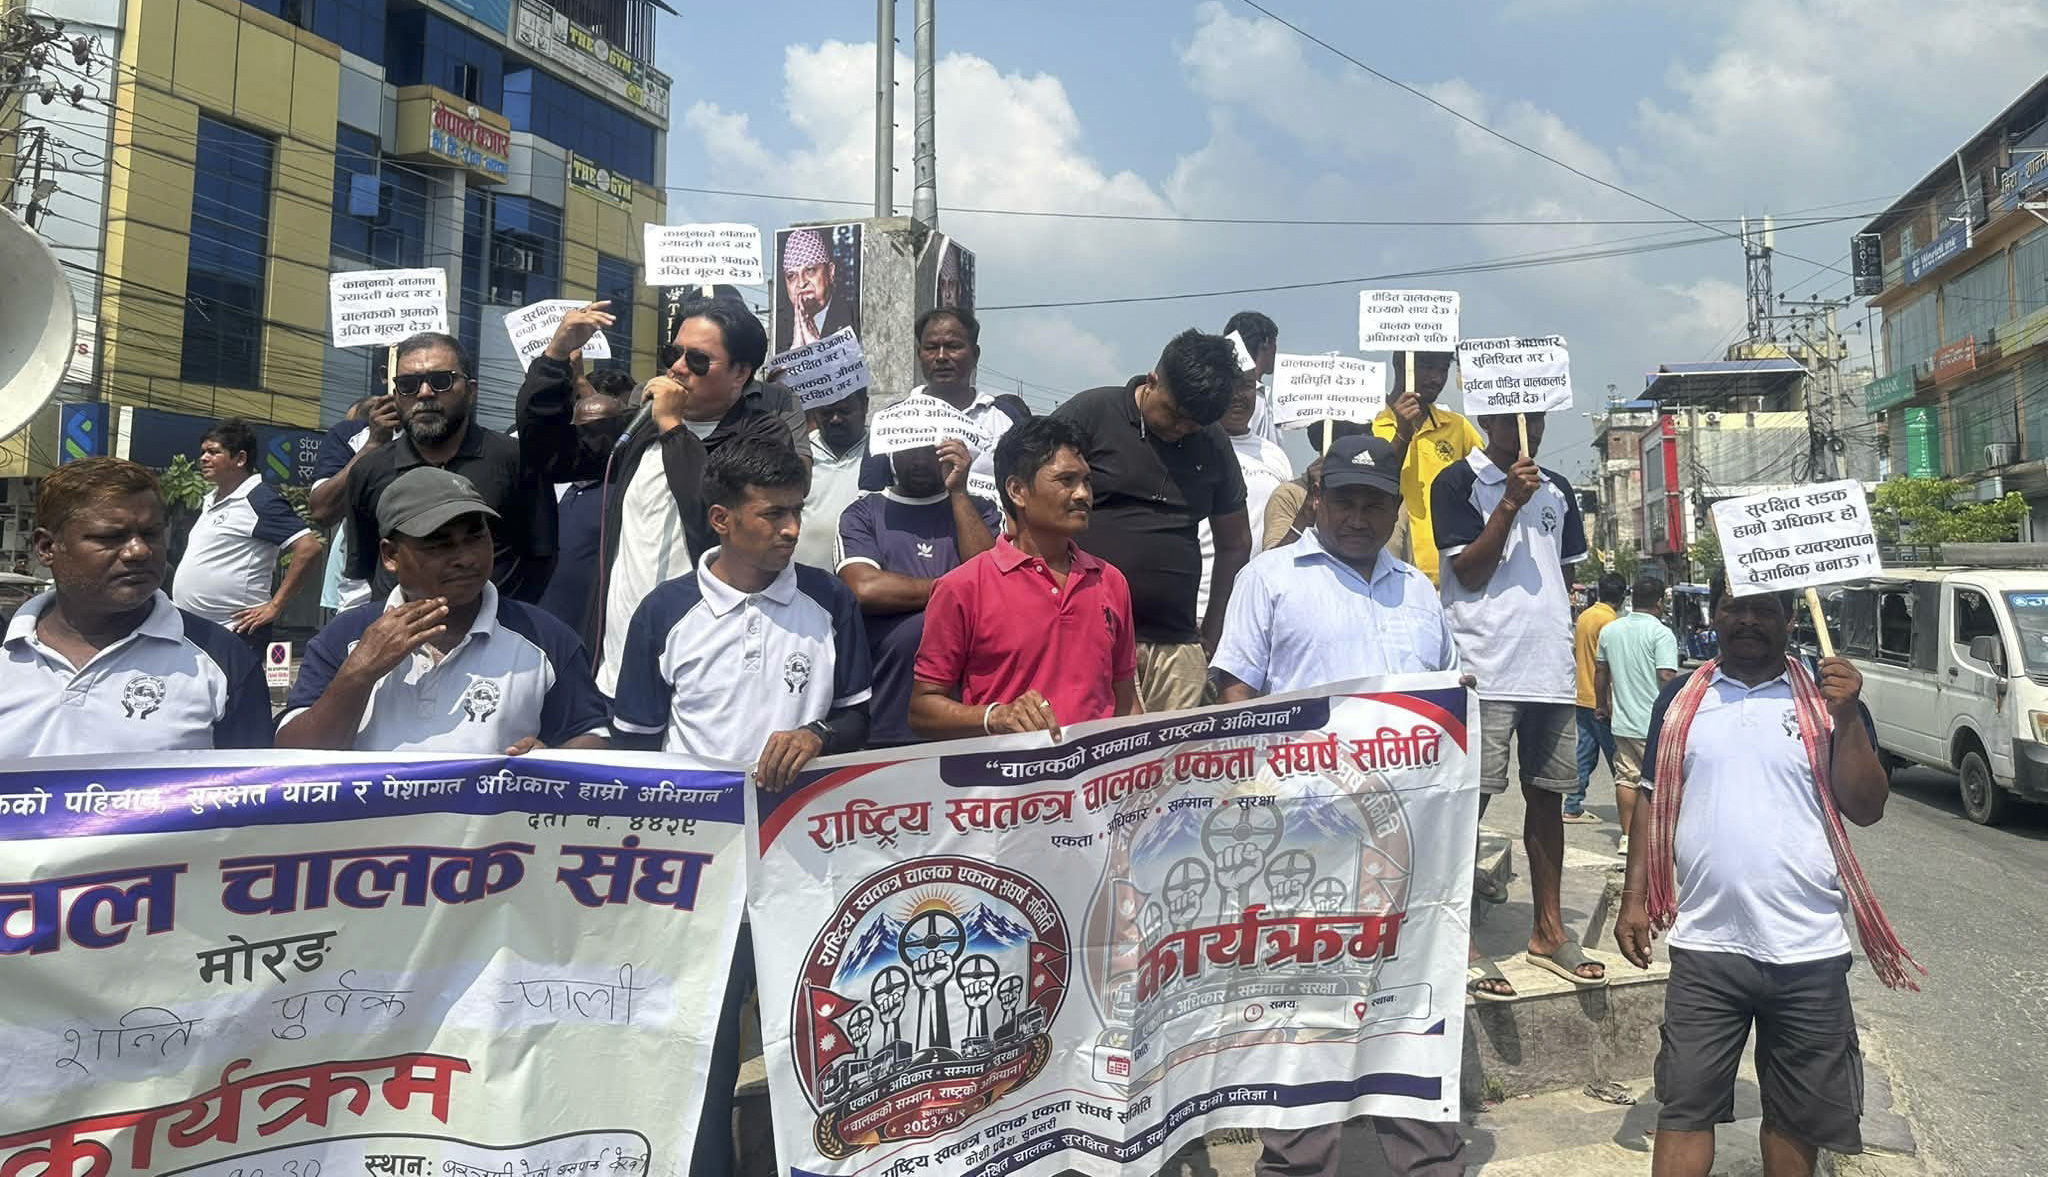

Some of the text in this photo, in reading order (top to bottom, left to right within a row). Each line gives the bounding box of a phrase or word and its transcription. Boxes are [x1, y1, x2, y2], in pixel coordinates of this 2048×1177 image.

[569, 25, 594, 53] THE
[608, 50, 632, 74] GYM
[573, 160, 597, 186] THE
[611, 177, 632, 200] GYM
[657, 265, 690, 276] उचित
[661, 255, 717, 264] चालकको
[341, 306, 439, 321] चालकको श्रमको
[1371, 292, 1400, 302] पीडित
[339, 324, 370, 337] उचित
[374, 323, 404, 336] मूल्य
[1379, 322, 1442, 331] चालक एकता
[771, 345, 814, 366] चालकको
[824, 353, 839, 363] गर
[1460, 339, 1510, 351] चालकको
[1527, 353, 1544, 362] गर
[836, 380, 852, 391] गर
[1495, 375, 1520, 389] पीडित
[1523, 373, 1567, 387] चालकलाई
[1744, 488, 1848, 519] सुरक्षित सडक
[1732, 504, 1858, 539] हाम्रो अधिकार हो
[1737, 532, 1875, 568] ट्राफिक व्यवस्थापन
[1749, 554, 1860, 583] वैज्ञानिक बनाऊ
[1158, 716, 1217, 741] राष्ट्रको
[282, 781, 342, 804] यात्रा
[352, 781, 373, 804] र
[382, 774, 467, 800] पेशागत
[476, 769, 570, 799] अधिकार
[578, 779, 629, 801] हाम्रो
[808, 799, 931, 850] राष्ट्रिय
[945, 790, 1076, 835] स्वतन्त्र
[1082, 758, 1165, 814] चालक
[1174, 746, 1257, 784] एकता
[1266, 732, 1340, 779] संघर्ष
[1350, 724, 1444, 773] समिति
[1051, 794, 1276, 848] एकता अधिकार सम्मान सुरक्षा
[219, 834, 715, 916] चालक संघ
[817, 864, 1057, 967] राष्ट्रिय स्वतन्त्र चालक एकता संघर्ष समिति
[196, 930, 338, 986] मोरङ
[1137, 903, 1408, 1002] कार्यक्रम
[849, 1088, 879, 1111] एकता
[888, 1068, 933, 1092] अधिकार
[943, 1063, 985, 1077] सम्मान
[939, 1081, 977, 1100] राष्ट्रको
[0, 1058, 473, 1177] कार्यक्रम
[934, 1131, 981, 1164] स्वतन्त्र
[984, 1110, 1029, 1139] चालक
[1031, 1099, 1072, 1120] एकता
[1075, 1101, 1113, 1122] संघर्ष
[1117, 1096, 1153, 1125] समिति
[1061, 1136, 1110, 1155] सुरक्षित
[1227, 1087, 1268, 1103] प्रतिज्ञा
[964, 1144, 991, 1167] कोशी
[1021, 1117, 1057, 1139] सुनसरी
